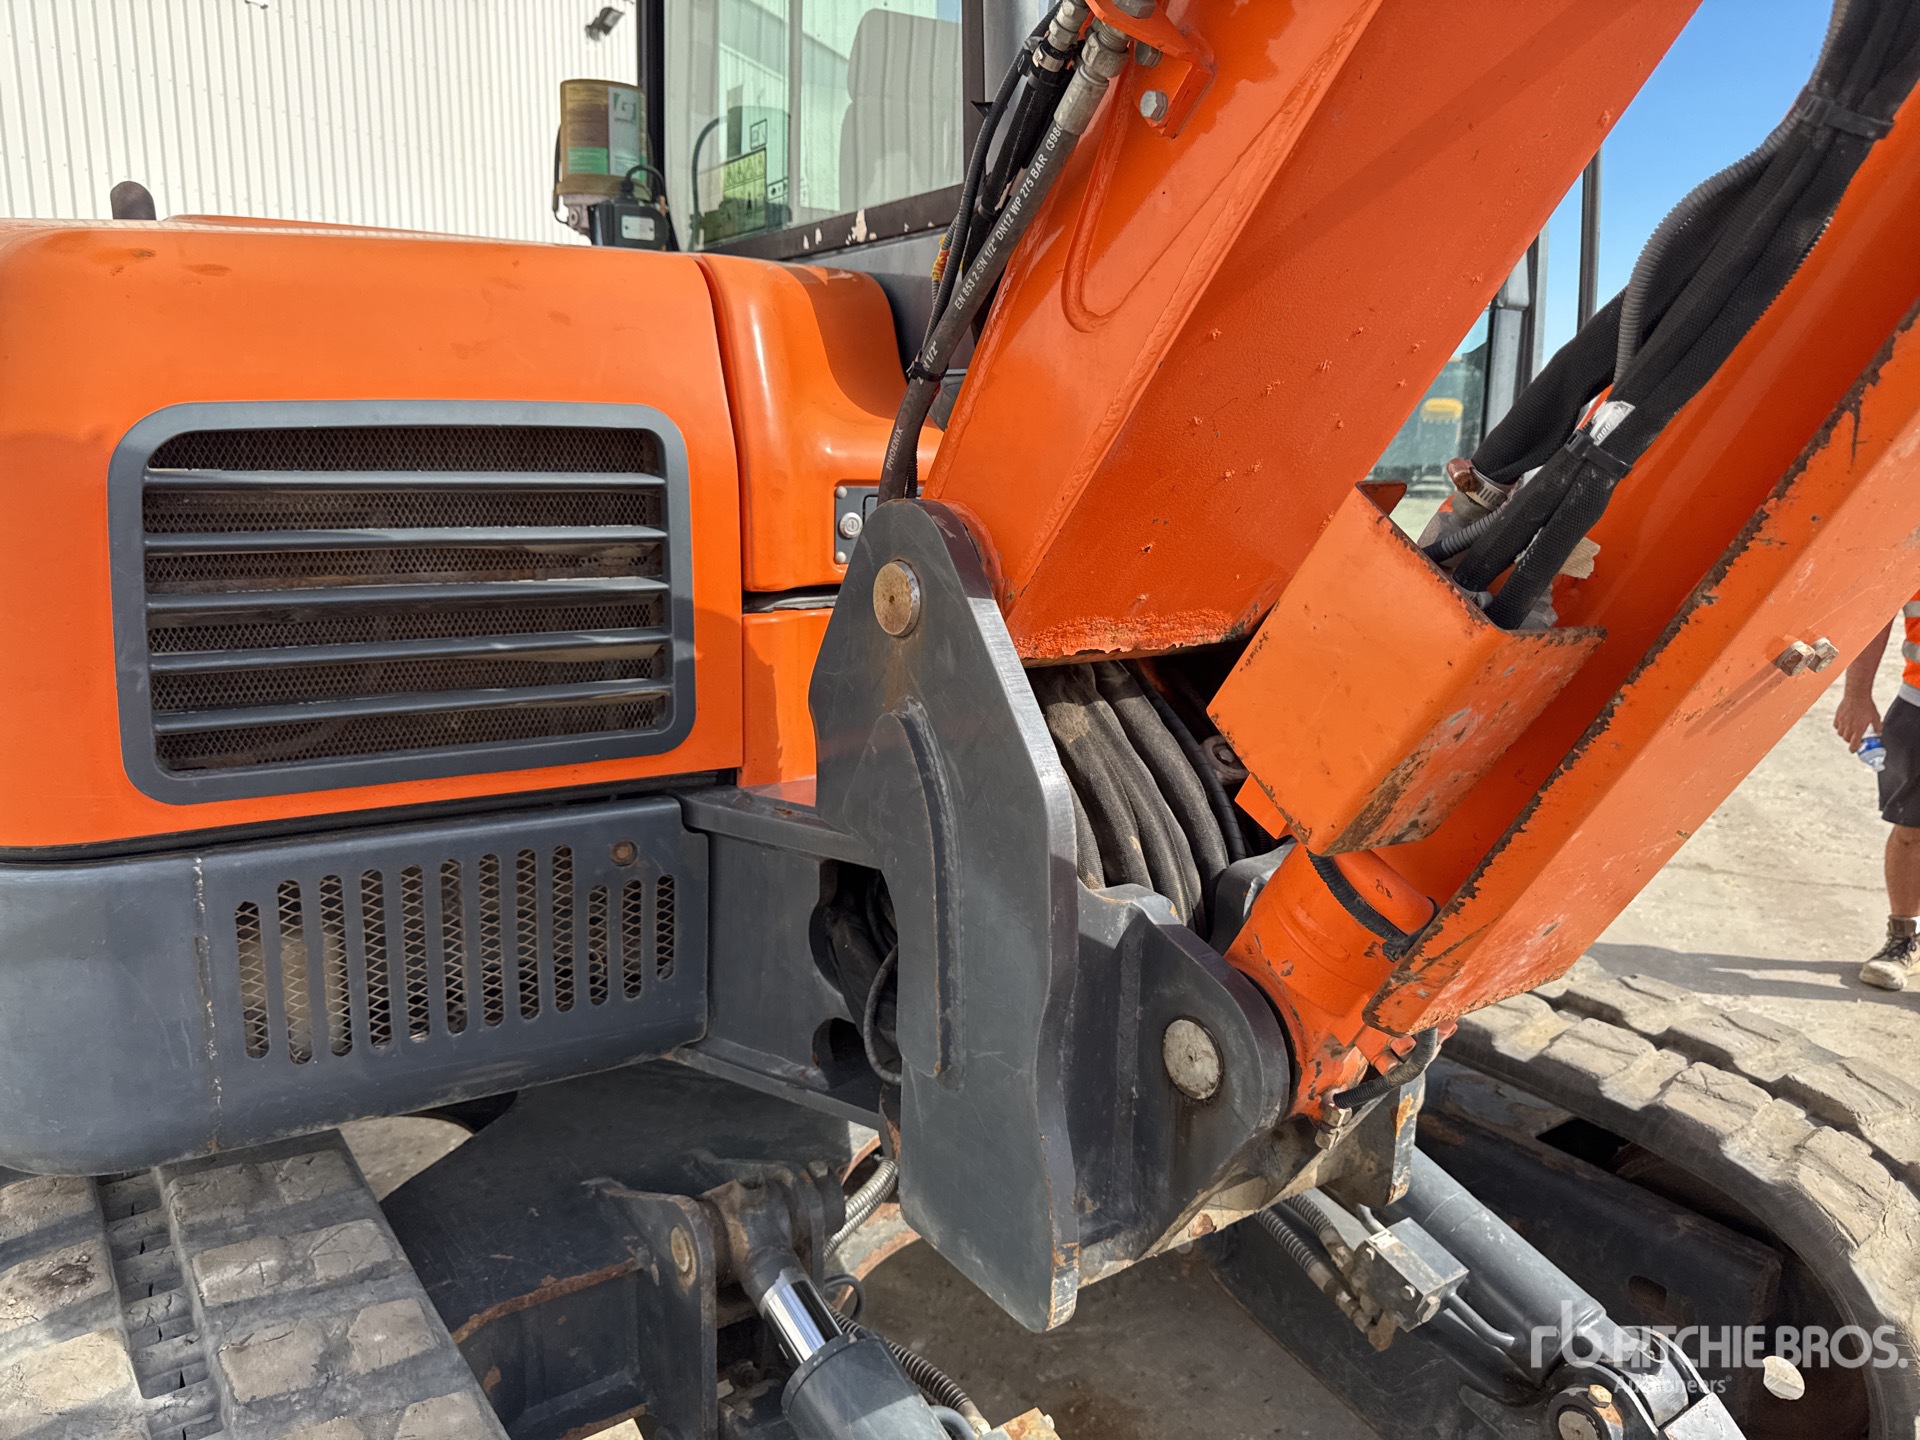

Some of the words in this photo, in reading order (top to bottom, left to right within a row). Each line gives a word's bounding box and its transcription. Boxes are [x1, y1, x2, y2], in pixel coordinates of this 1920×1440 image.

[954, 293, 966, 310] EN
[962, 278, 976, 297] 853
[972, 271, 980, 281] 2
[976, 257, 988, 273] SN
[995, 213, 1014, 241] DN12
[1010, 196, 1022, 215] WP
[1020, 177, 1034, 198] 275
[1030, 152, 1048, 179] BAR
[885, 425, 904, 471] PHOENIX
